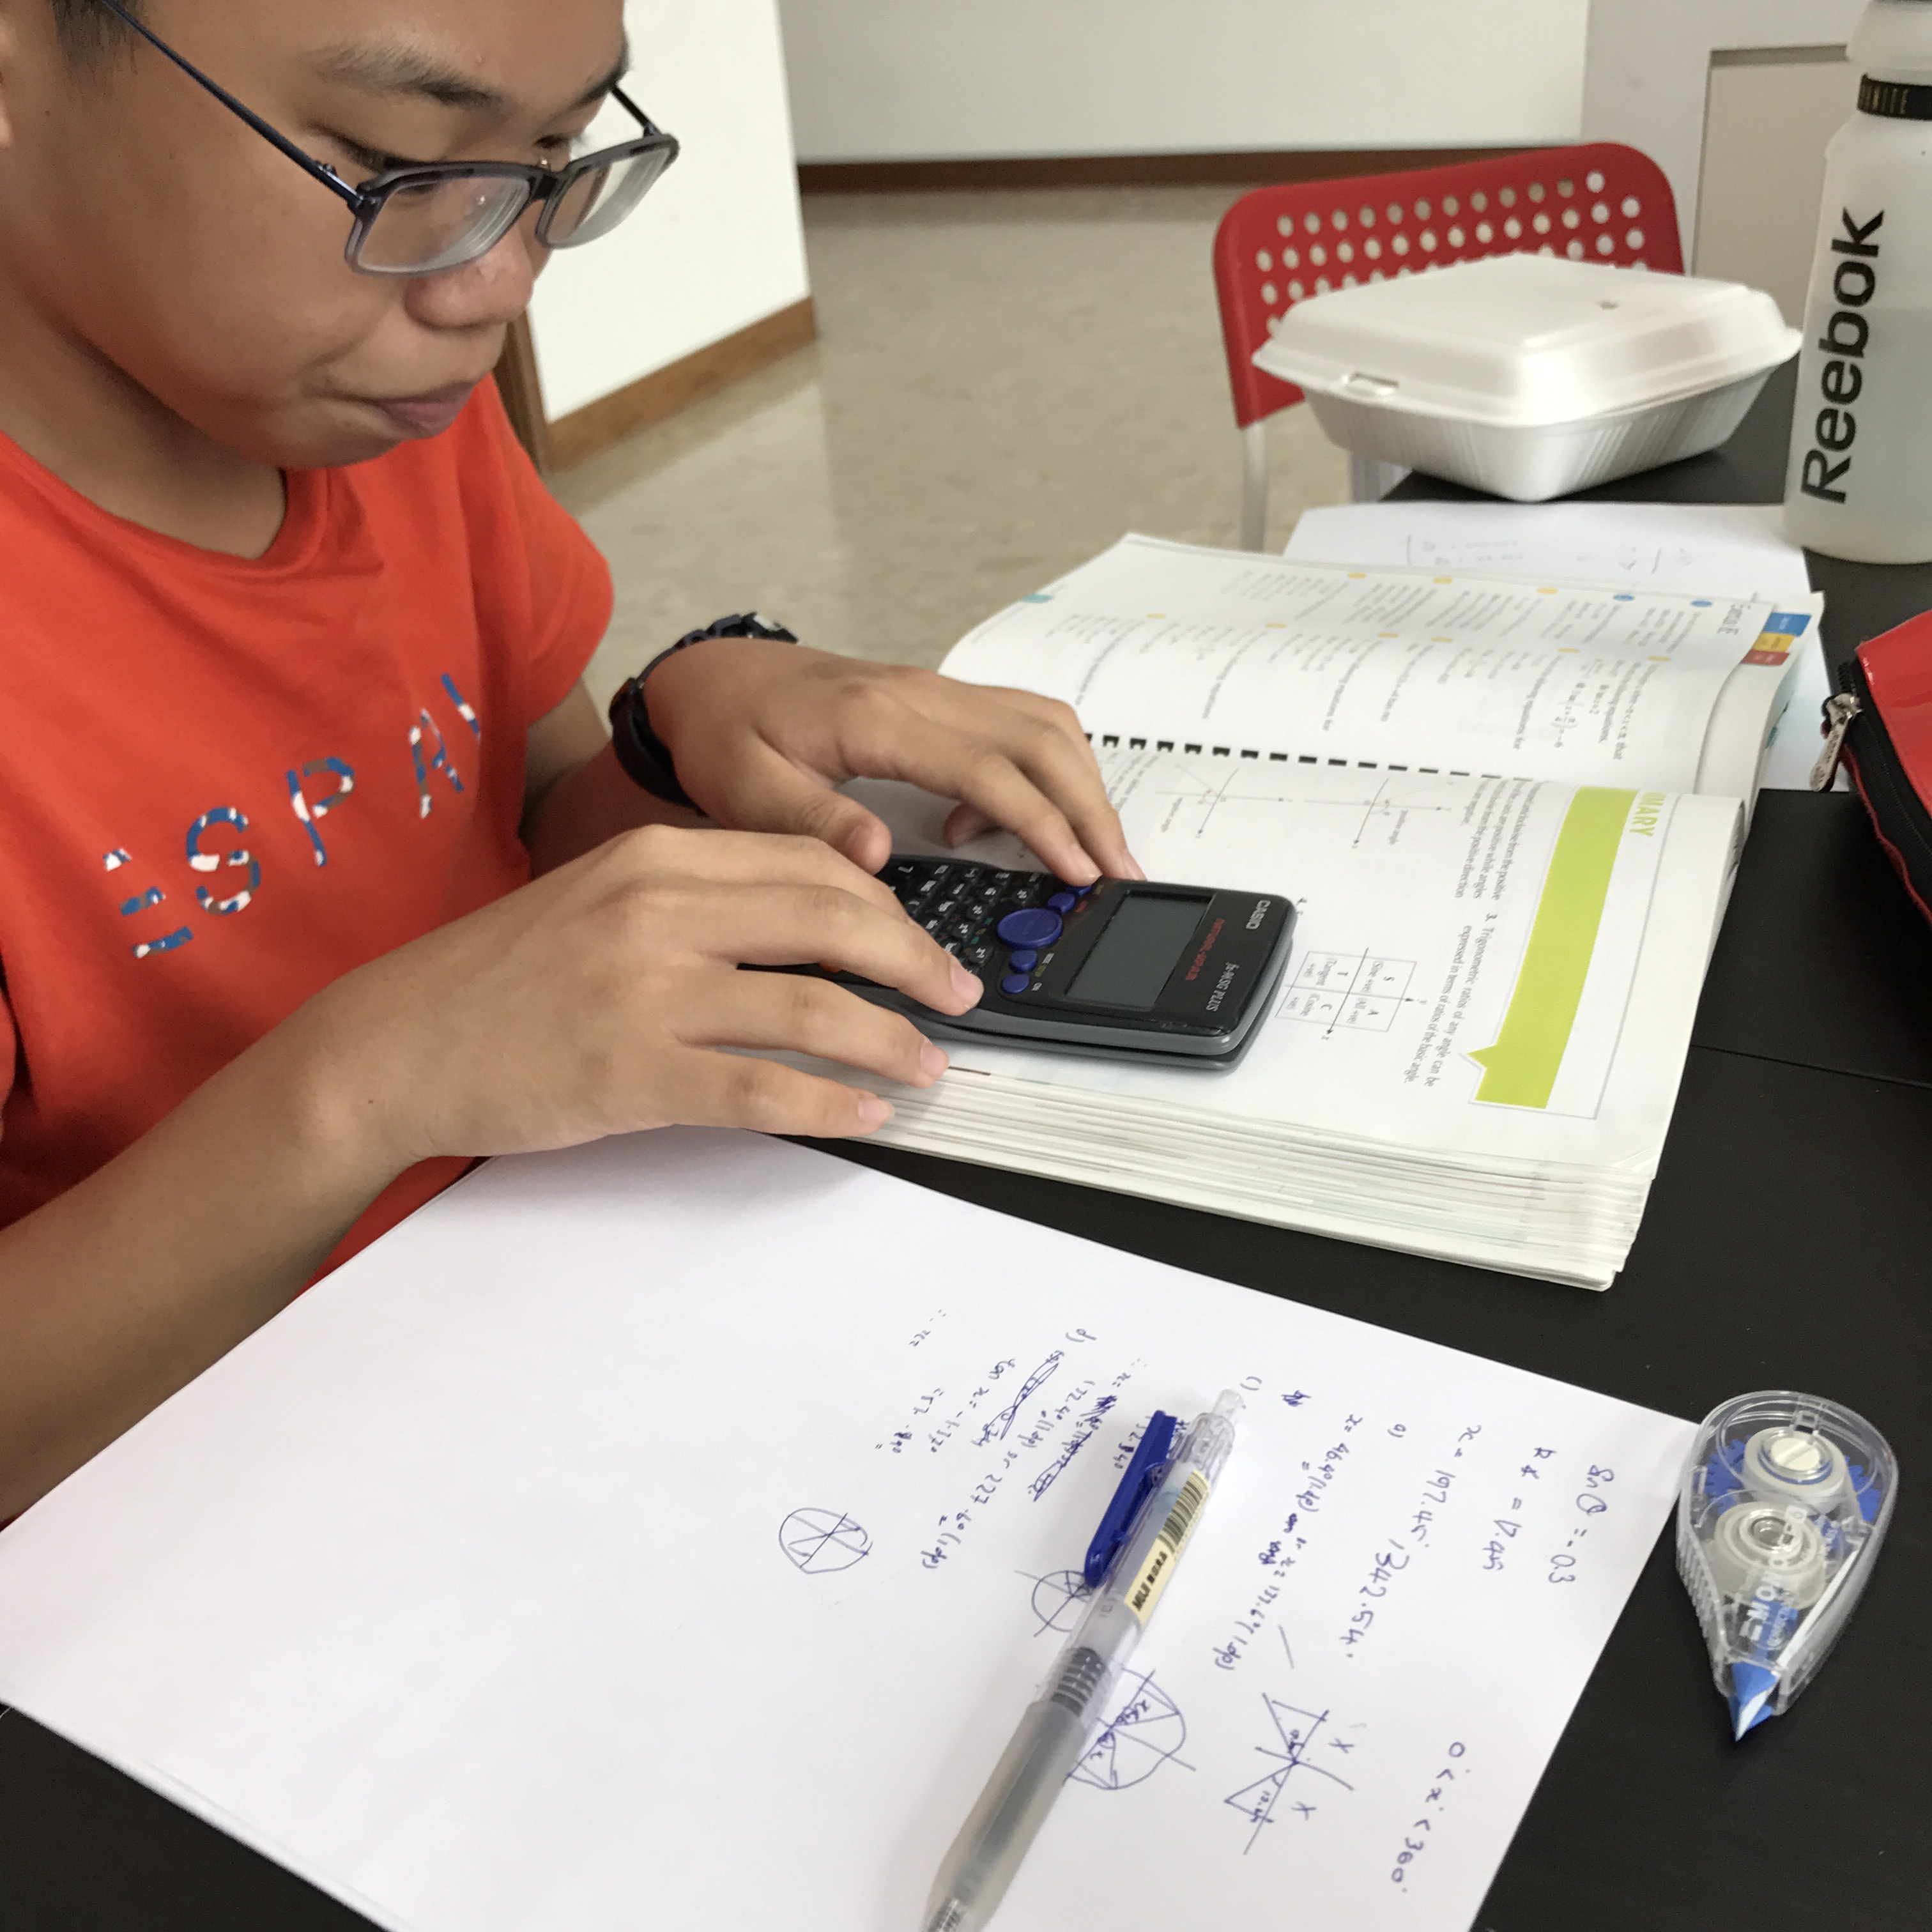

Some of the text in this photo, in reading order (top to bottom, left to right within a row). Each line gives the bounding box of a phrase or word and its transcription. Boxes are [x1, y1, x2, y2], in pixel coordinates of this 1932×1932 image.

[1801, 207, 1884, 504] Reebok
[1246, 900, 1271, 930] CASIO
[1453, 925, 1473, 964] expressed
[1441, 974, 1458, 994] terms
[1205, 990, 1227, 1011] PLUS
[1424, 913, 1499, 1086] 3. Trigonometric ratios of any angle can be
[1438, 995, 1452, 1004] of
[1430, 1004, 1447, 1022] ratios
[1422, 1032, 1438, 1043] the
[1427, 1023, 1440, 1032] of
[1414, 1044, 1434, 1061] basic
[1404, 1062, 1422, 1083] angle.
